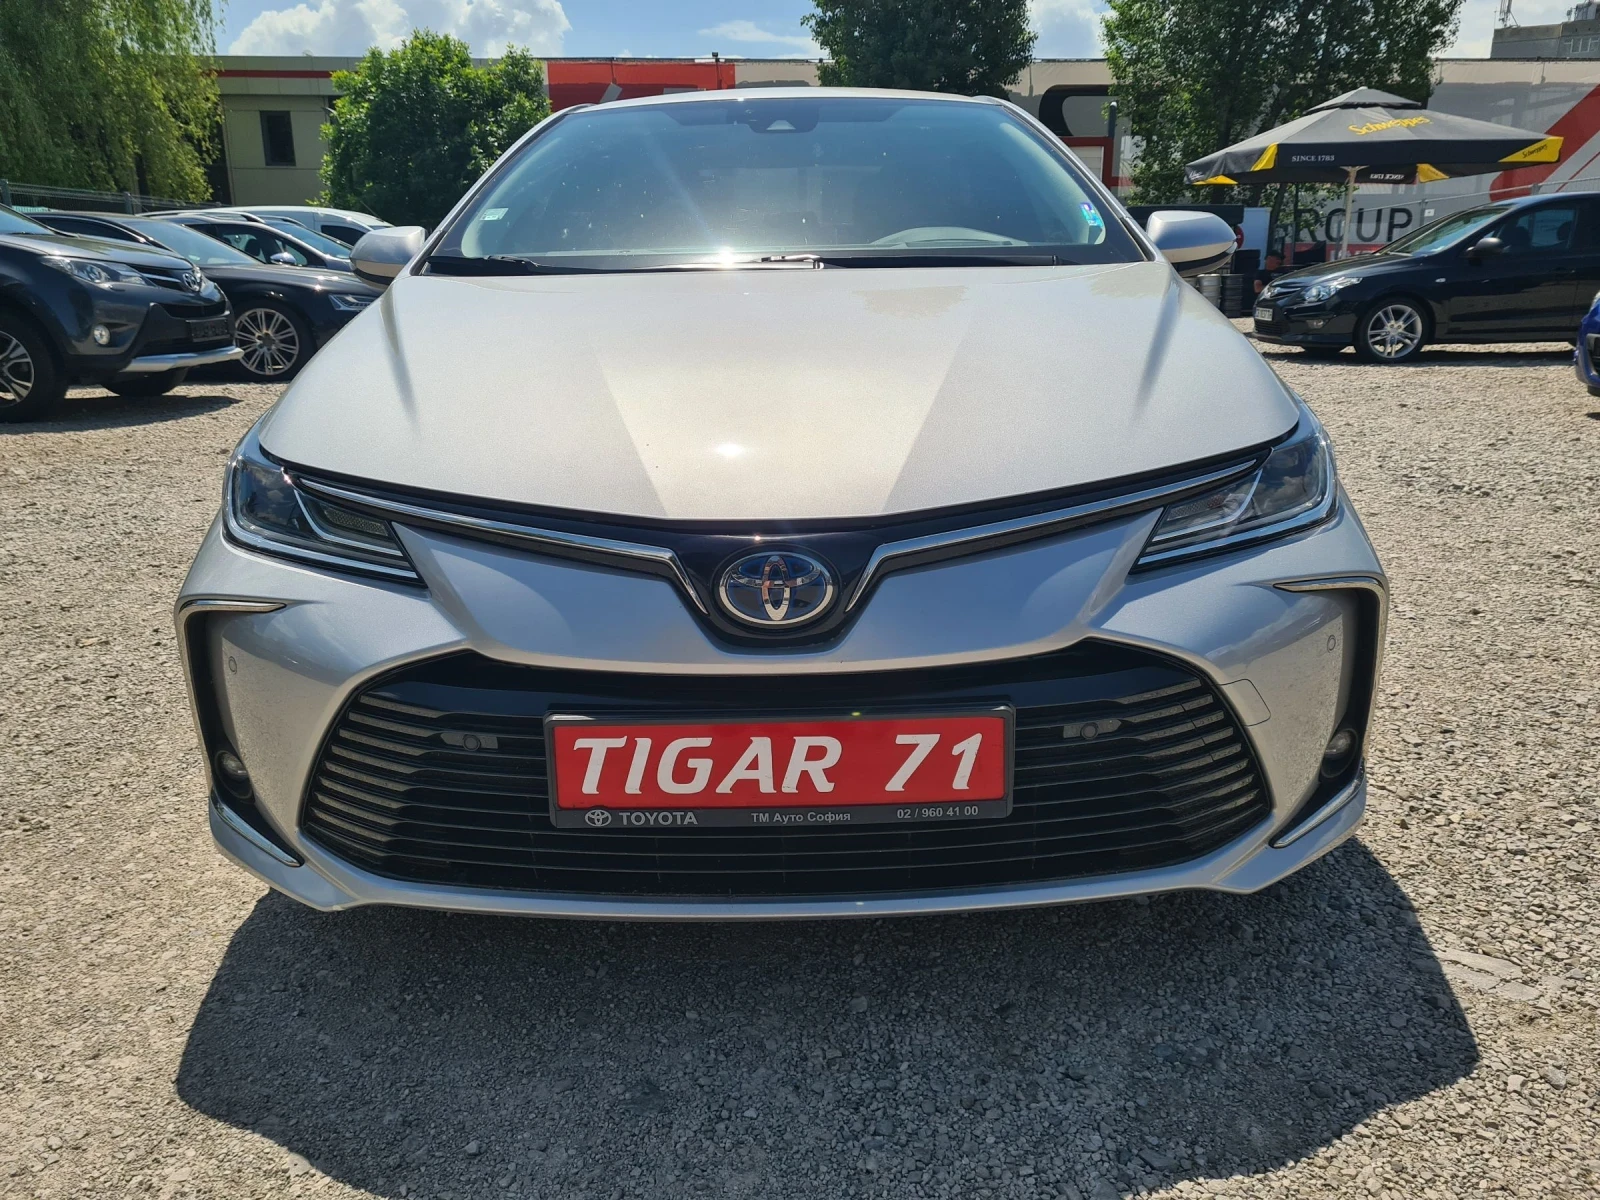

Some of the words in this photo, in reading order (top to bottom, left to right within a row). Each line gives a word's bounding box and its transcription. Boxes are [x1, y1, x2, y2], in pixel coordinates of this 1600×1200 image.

[1278, 207, 1413, 243] ROUP
[573, 735, 843, 795] TIGAR
[884, 732, 983, 792] 71
[619, 811, 699, 826] TOYOTA
[773, 811, 804, 825] Ауто
[807, 810, 851, 824] София
[897, 808, 911, 819] 02
[921, 806, 944, 819] 960
[946, 806, 961, 817] 41
[964, 805, 979, 817] 00
